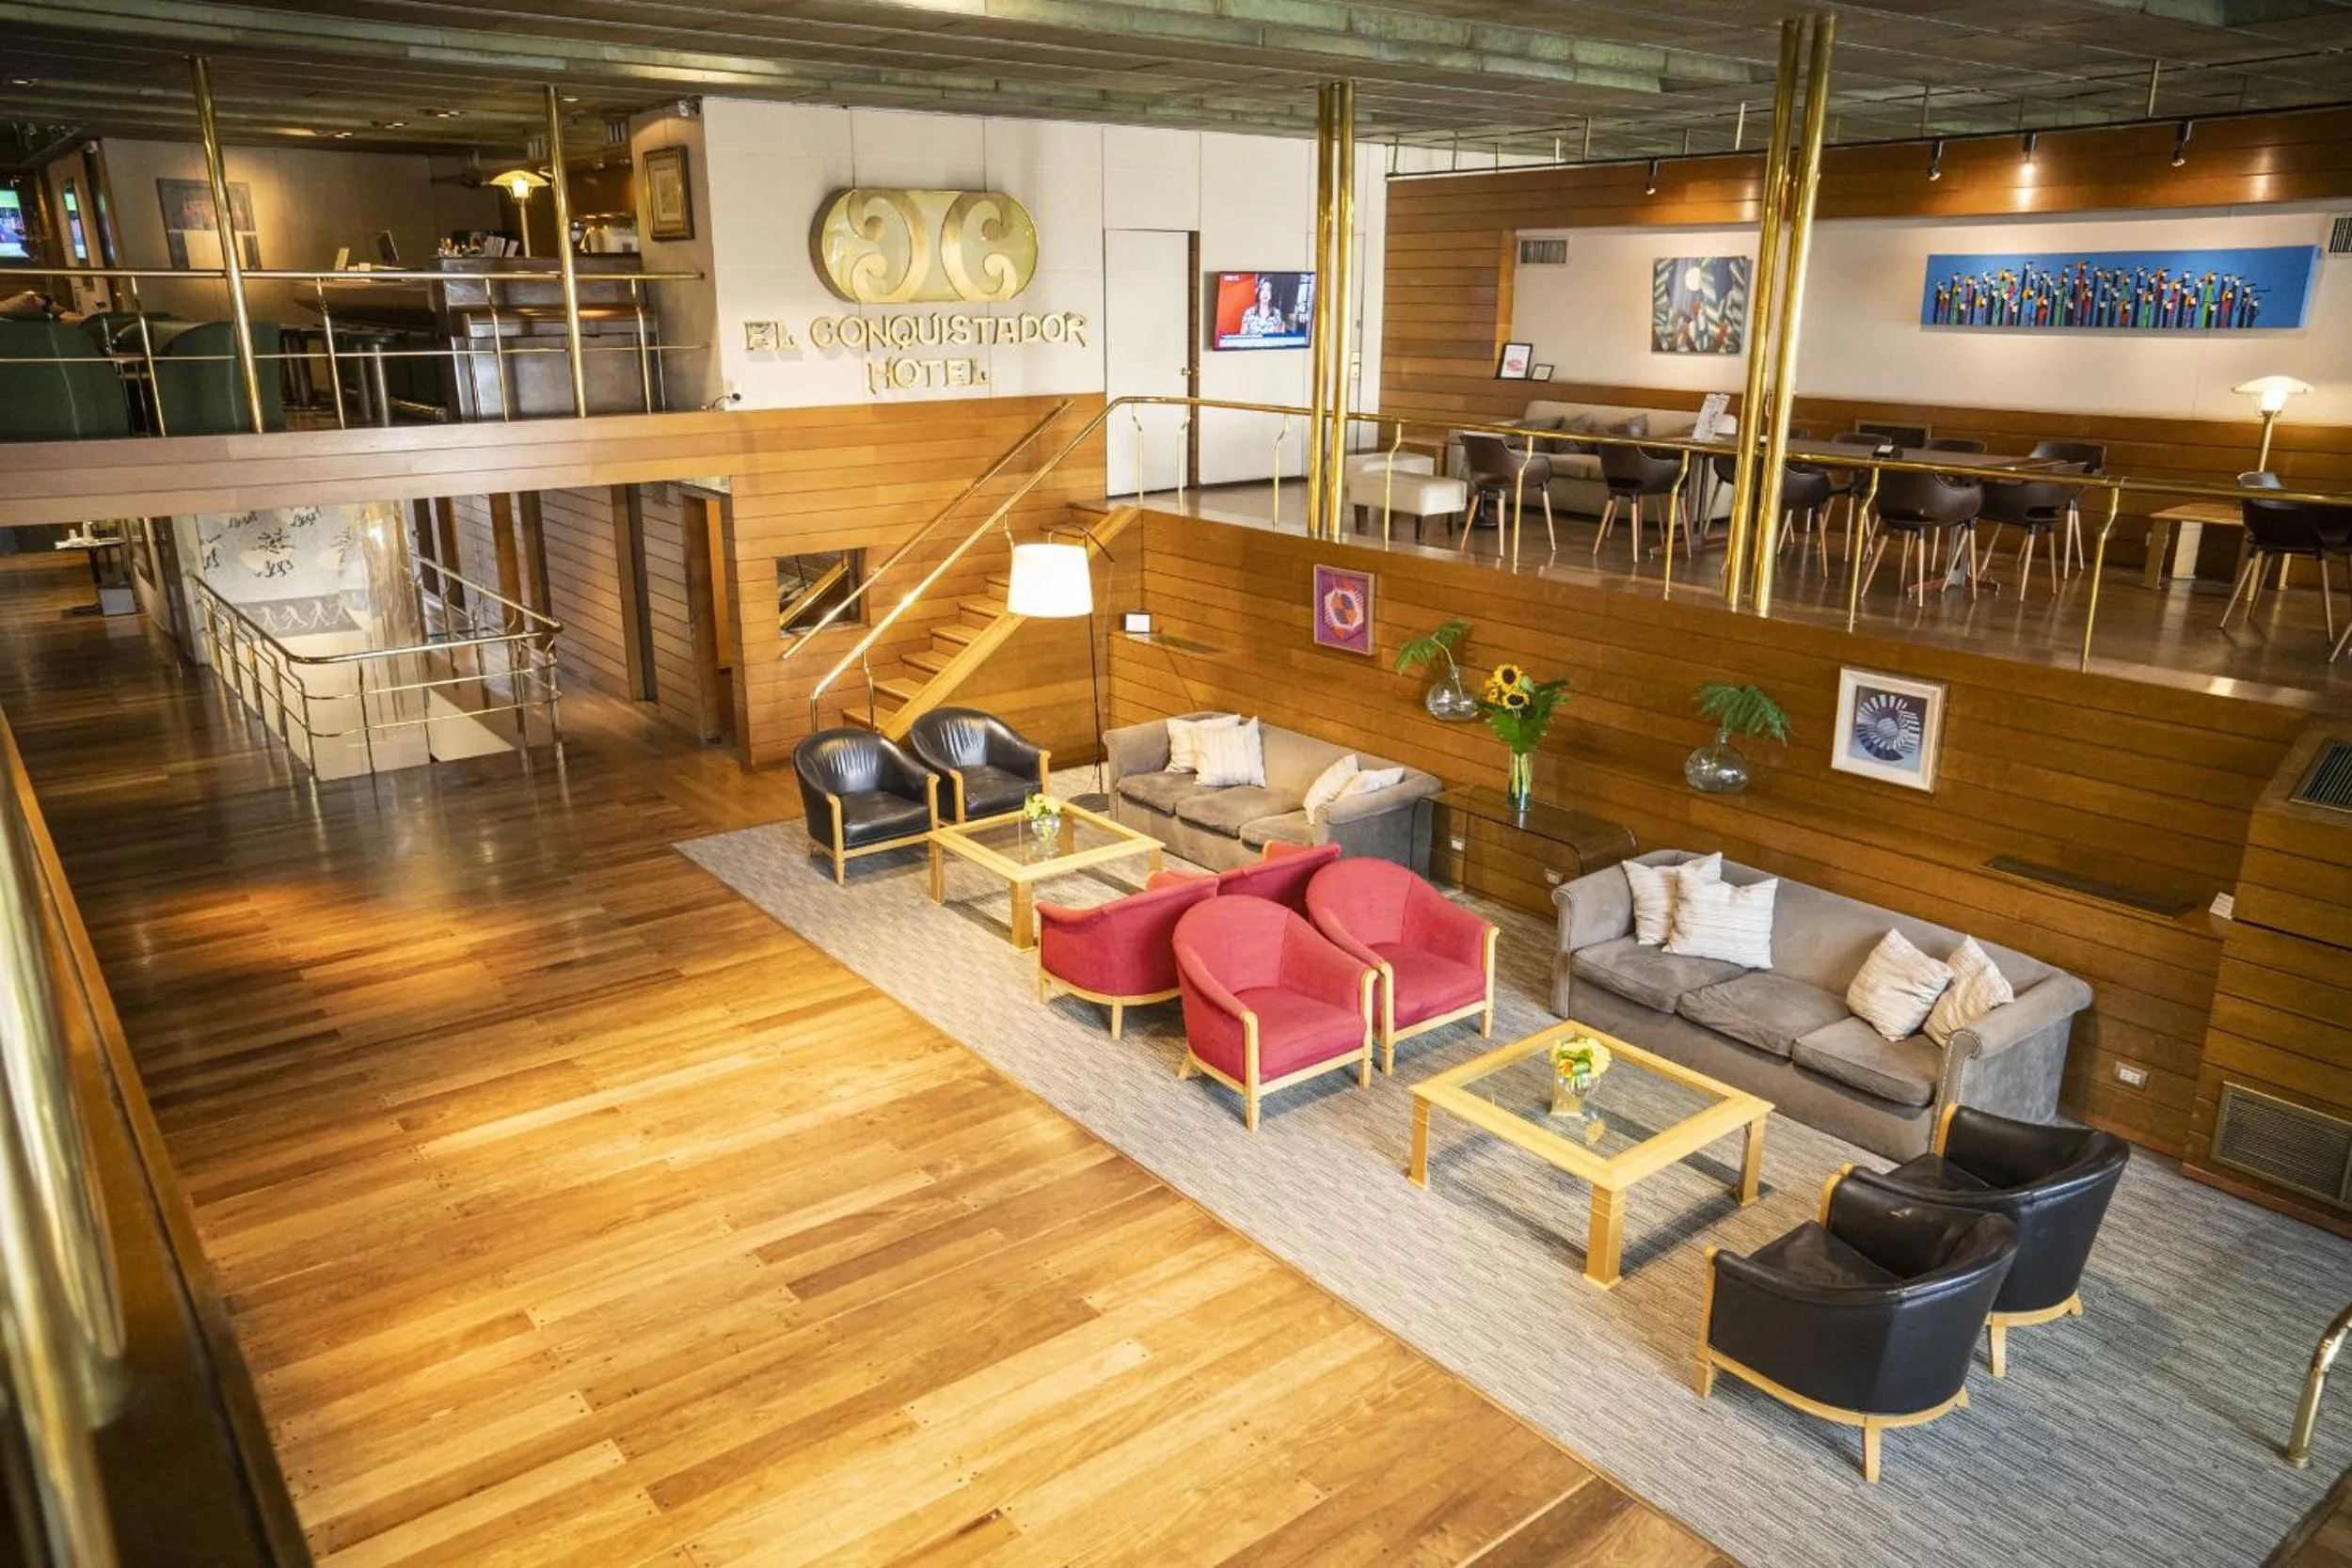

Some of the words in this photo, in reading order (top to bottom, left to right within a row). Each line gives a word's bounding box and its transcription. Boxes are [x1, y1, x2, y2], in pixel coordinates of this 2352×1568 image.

[744, 321, 800, 351] EL
[809, 311, 1087, 351] CONQUISTADOR
[866, 356, 988, 395] HOTEL
